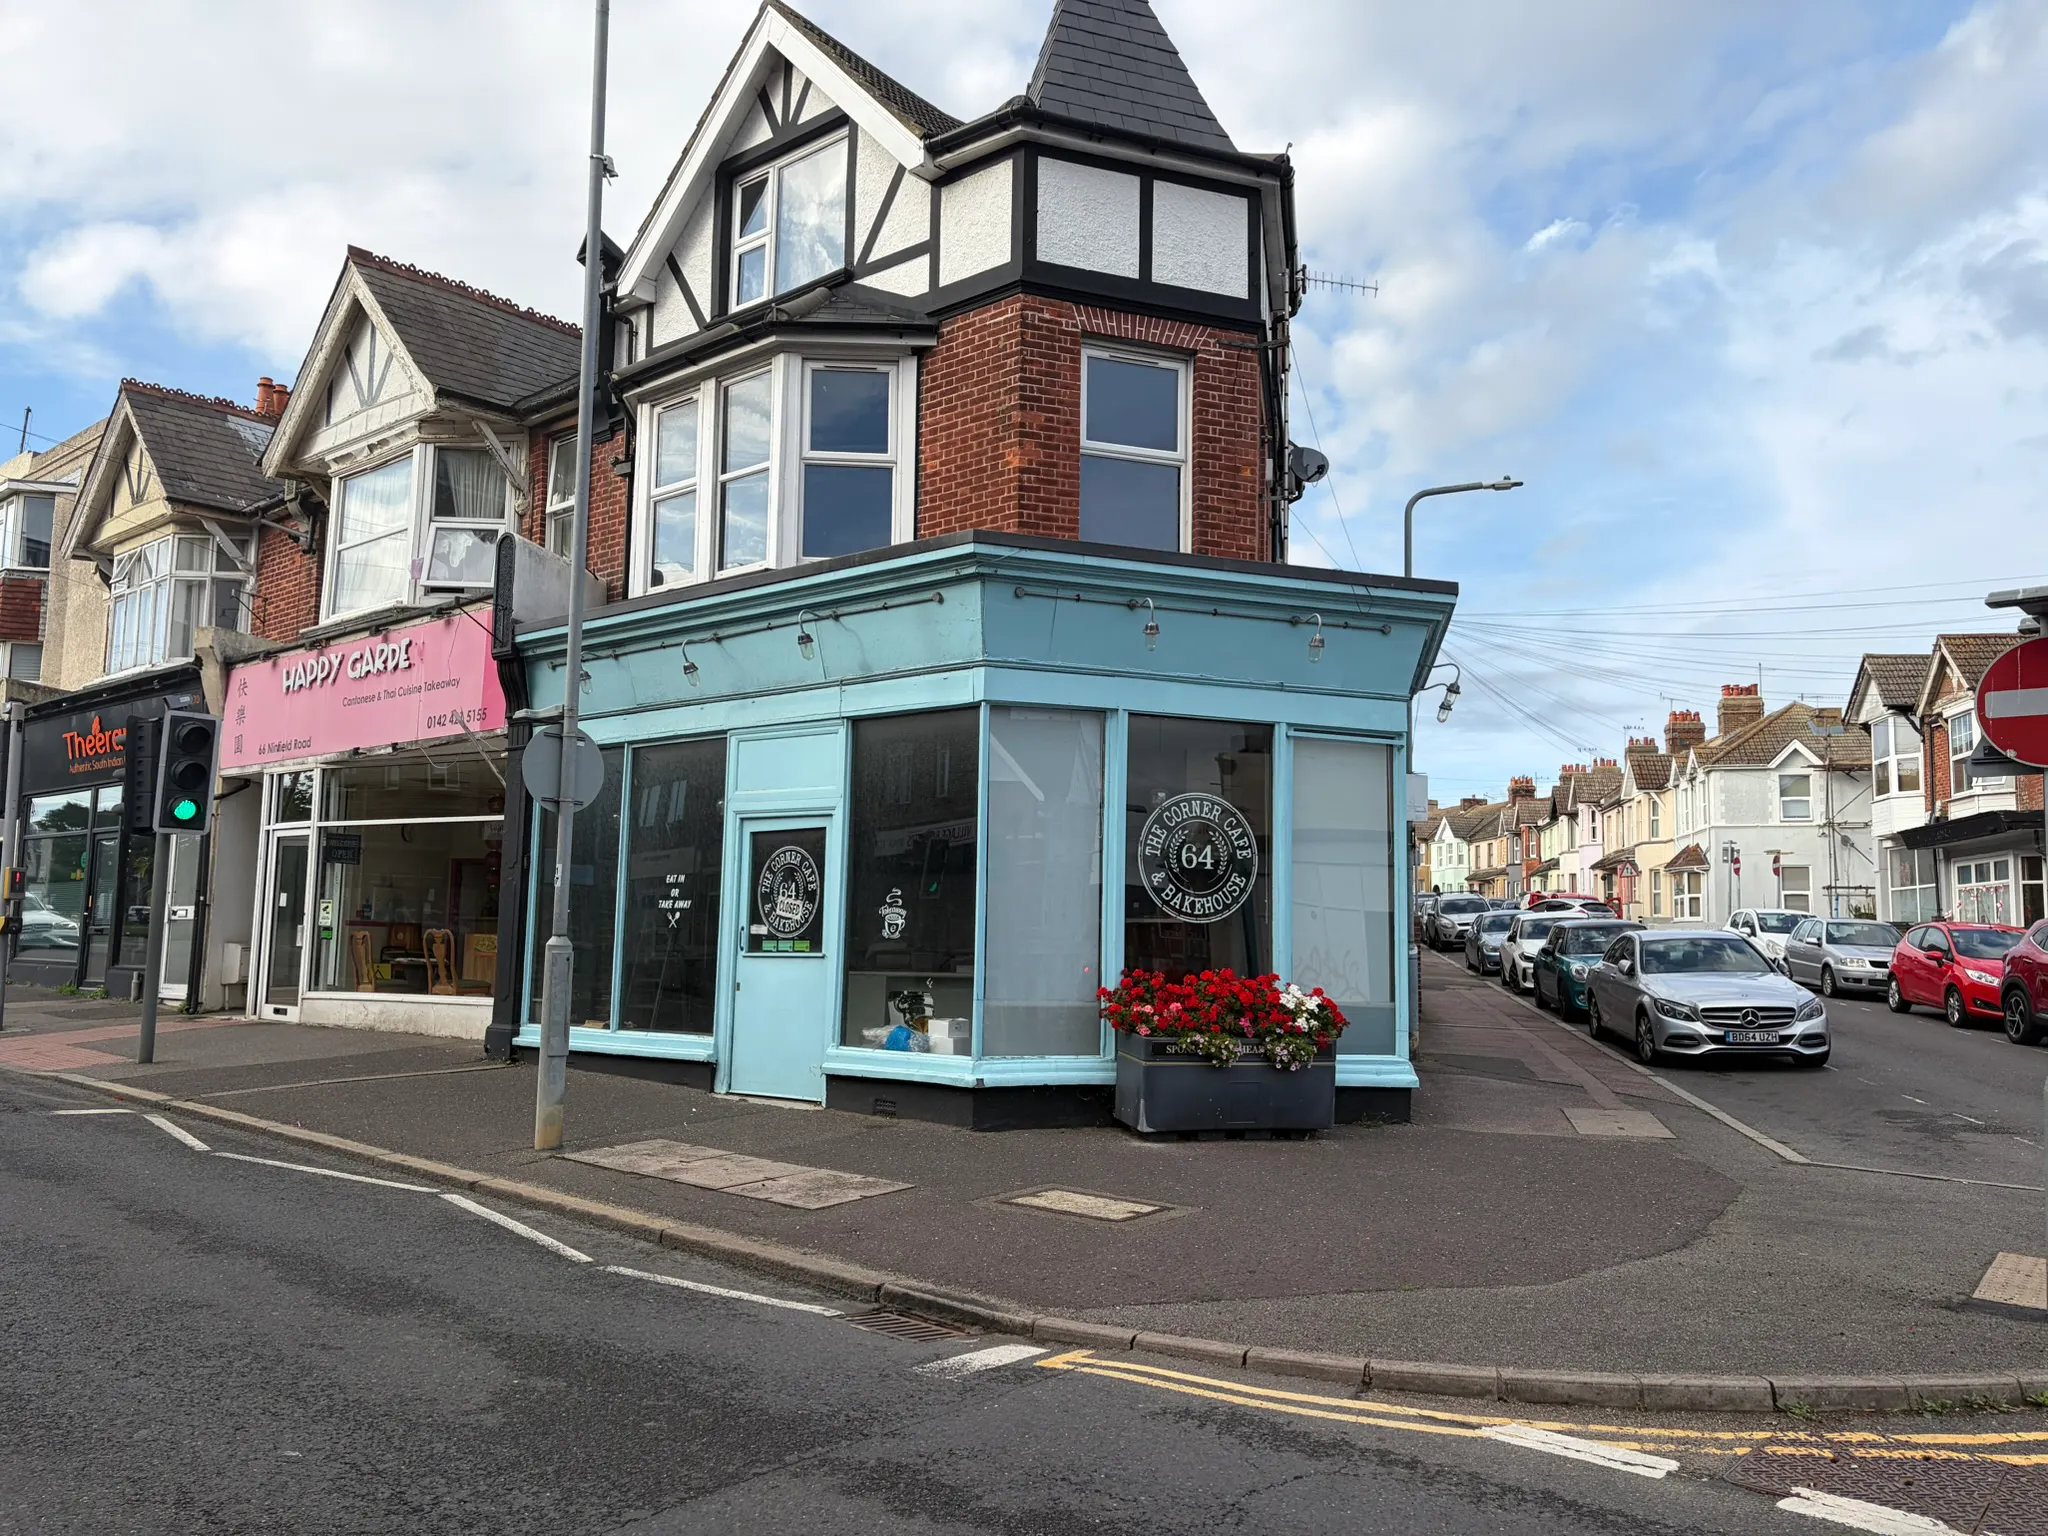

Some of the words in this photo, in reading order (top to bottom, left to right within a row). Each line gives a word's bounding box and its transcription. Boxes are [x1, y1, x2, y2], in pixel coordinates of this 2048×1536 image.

[282, 652, 344, 695] HAPPY
[347, 637, 412, 680] GARDE
[342, 694, 376, 707] Cantonese
[377, 691, 382, 701] &
[383, 688, 396, 700] Thai
[398, 684, 422, 698] Cuisine
[424, 677, 461, 692] Takeaway
[427, 713, 447, 729] 0142
[466, 707, 488, 723] 5155
[258, 743, 266, 755] 66
[294, 736, 312, 751] Road
[92, 758, 108, 771] South
[108, 756, 124, 768] Indian
[1145, 824, 1168, 856] THE
[1163, 800, 1222, 826] CORNER
[1223, 817, 1252, 860] CAFE
[1181, 843, 1215, 870] 64
[665, 874, 677, 884] EAT
[677, 874, 686, 883] IN
[761, 870, 774, 894] THE
[770, 851, 802, 872] CORNER
[801, 861, 817, 892] CAFE
[670, 888, 680, 898] OR
[779, 882, 797, 900] 64
[1151, 871, 1166, 886] &
[1161, 872, 1247, 915] BAKEHOUSE
[658, 899, 673, 909] TAKE
[673, 899, 692, 909] AWAY
[778, 899, 801, 916] CLOSED
[764, 903, 772, 914] &
[768, 900, 814, 932] BAKEHOUSE
[1732, 1032, 1757, 1042] BD64
[1759, 1032, 1778, 1042] UZH
